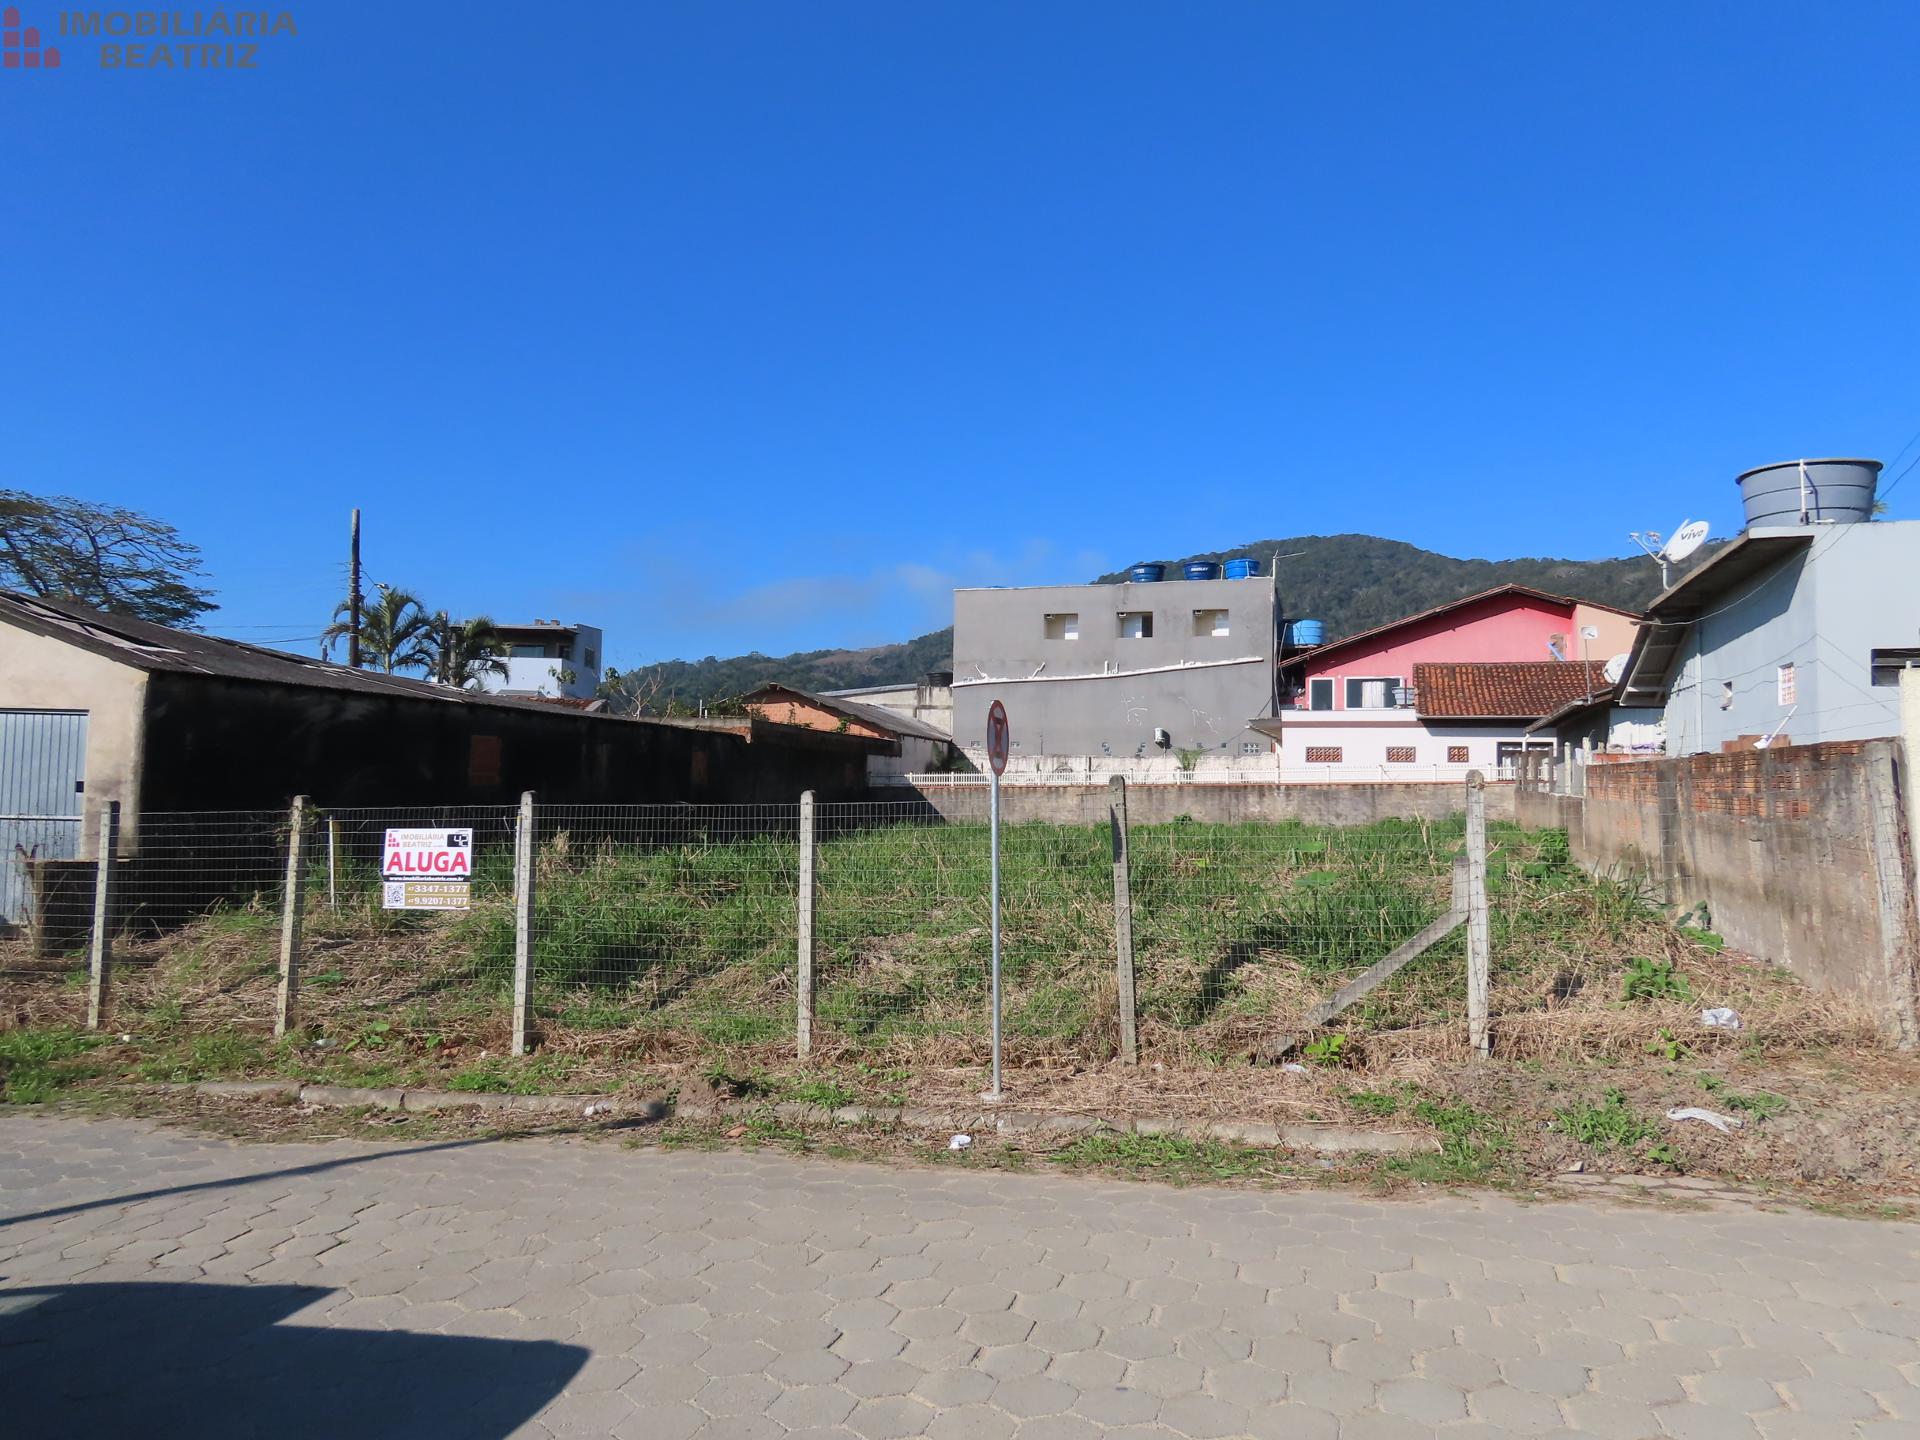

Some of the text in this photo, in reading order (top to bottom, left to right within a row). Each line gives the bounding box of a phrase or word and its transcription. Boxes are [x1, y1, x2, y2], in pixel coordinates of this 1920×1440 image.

[1681, 529, 1704, 540] vivo
[387, 851, 468, 872] ALUGA
[414, 885, 468, 893] 3347-1377
[414, 897, 468, 905] 9.9207-1377
